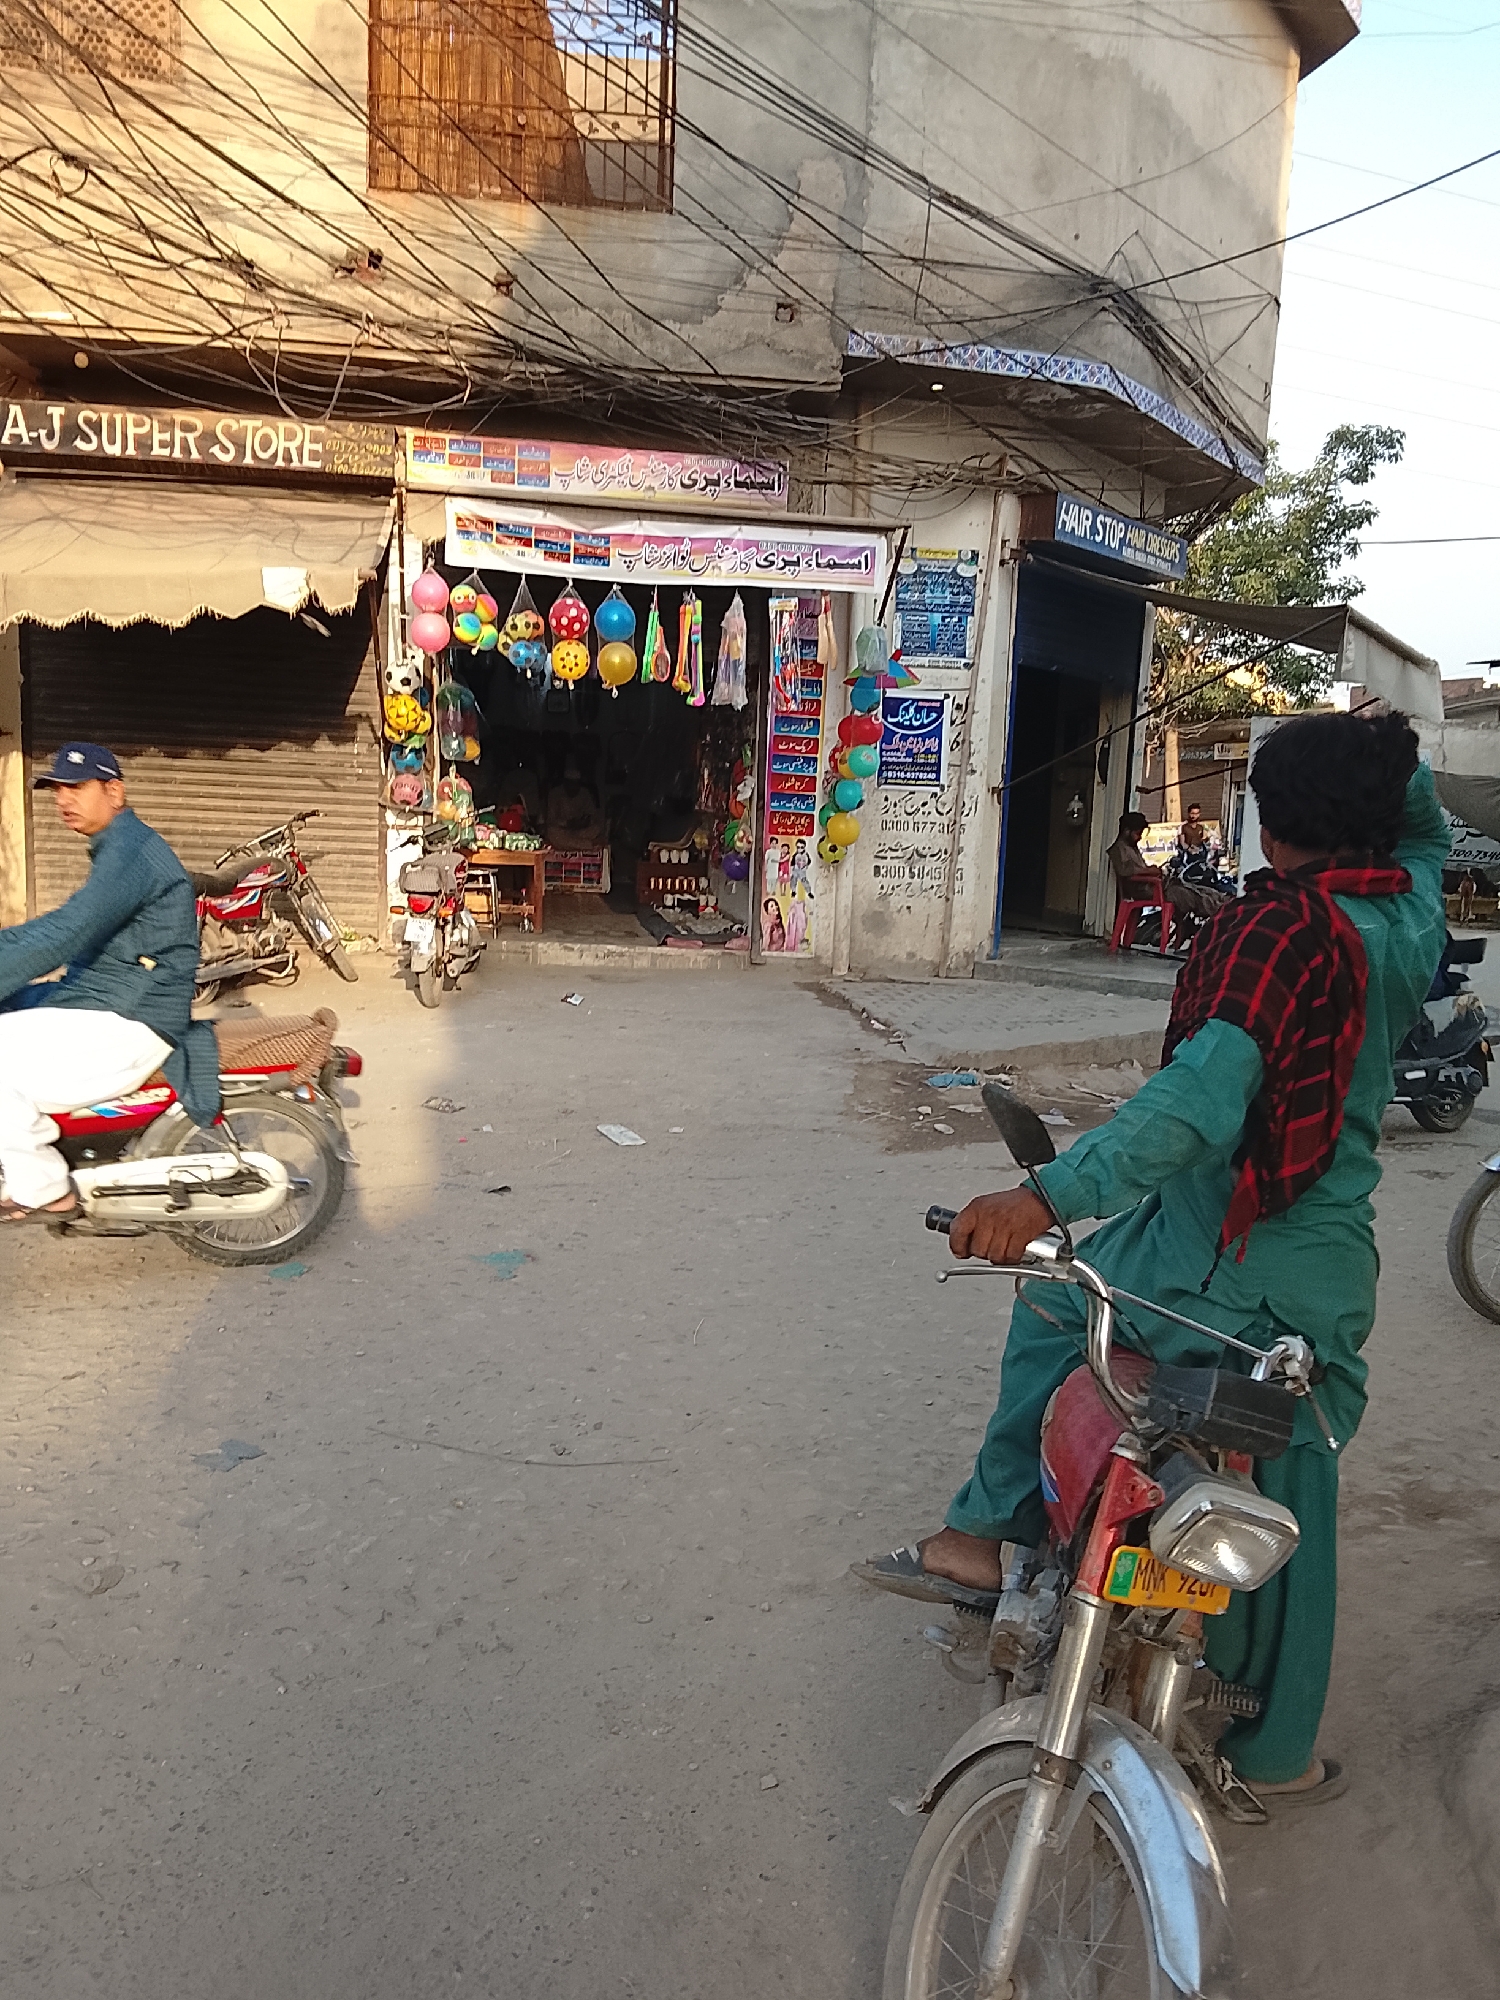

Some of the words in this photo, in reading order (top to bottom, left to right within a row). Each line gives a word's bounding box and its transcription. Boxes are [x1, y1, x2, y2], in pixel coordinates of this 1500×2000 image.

[72, 410, 203, 459] SUPER
[208, 418, 326, 469] STORE
[554, 457, 591, 490] شاپ
[680, 467, 722, 500] پری
[755, 550, 802, 578] پری
[802, 547, 871, 575] اسماء
[1146, 531, 1181, 564] DRESSERS
[881, 819, 909, 832] 0300
